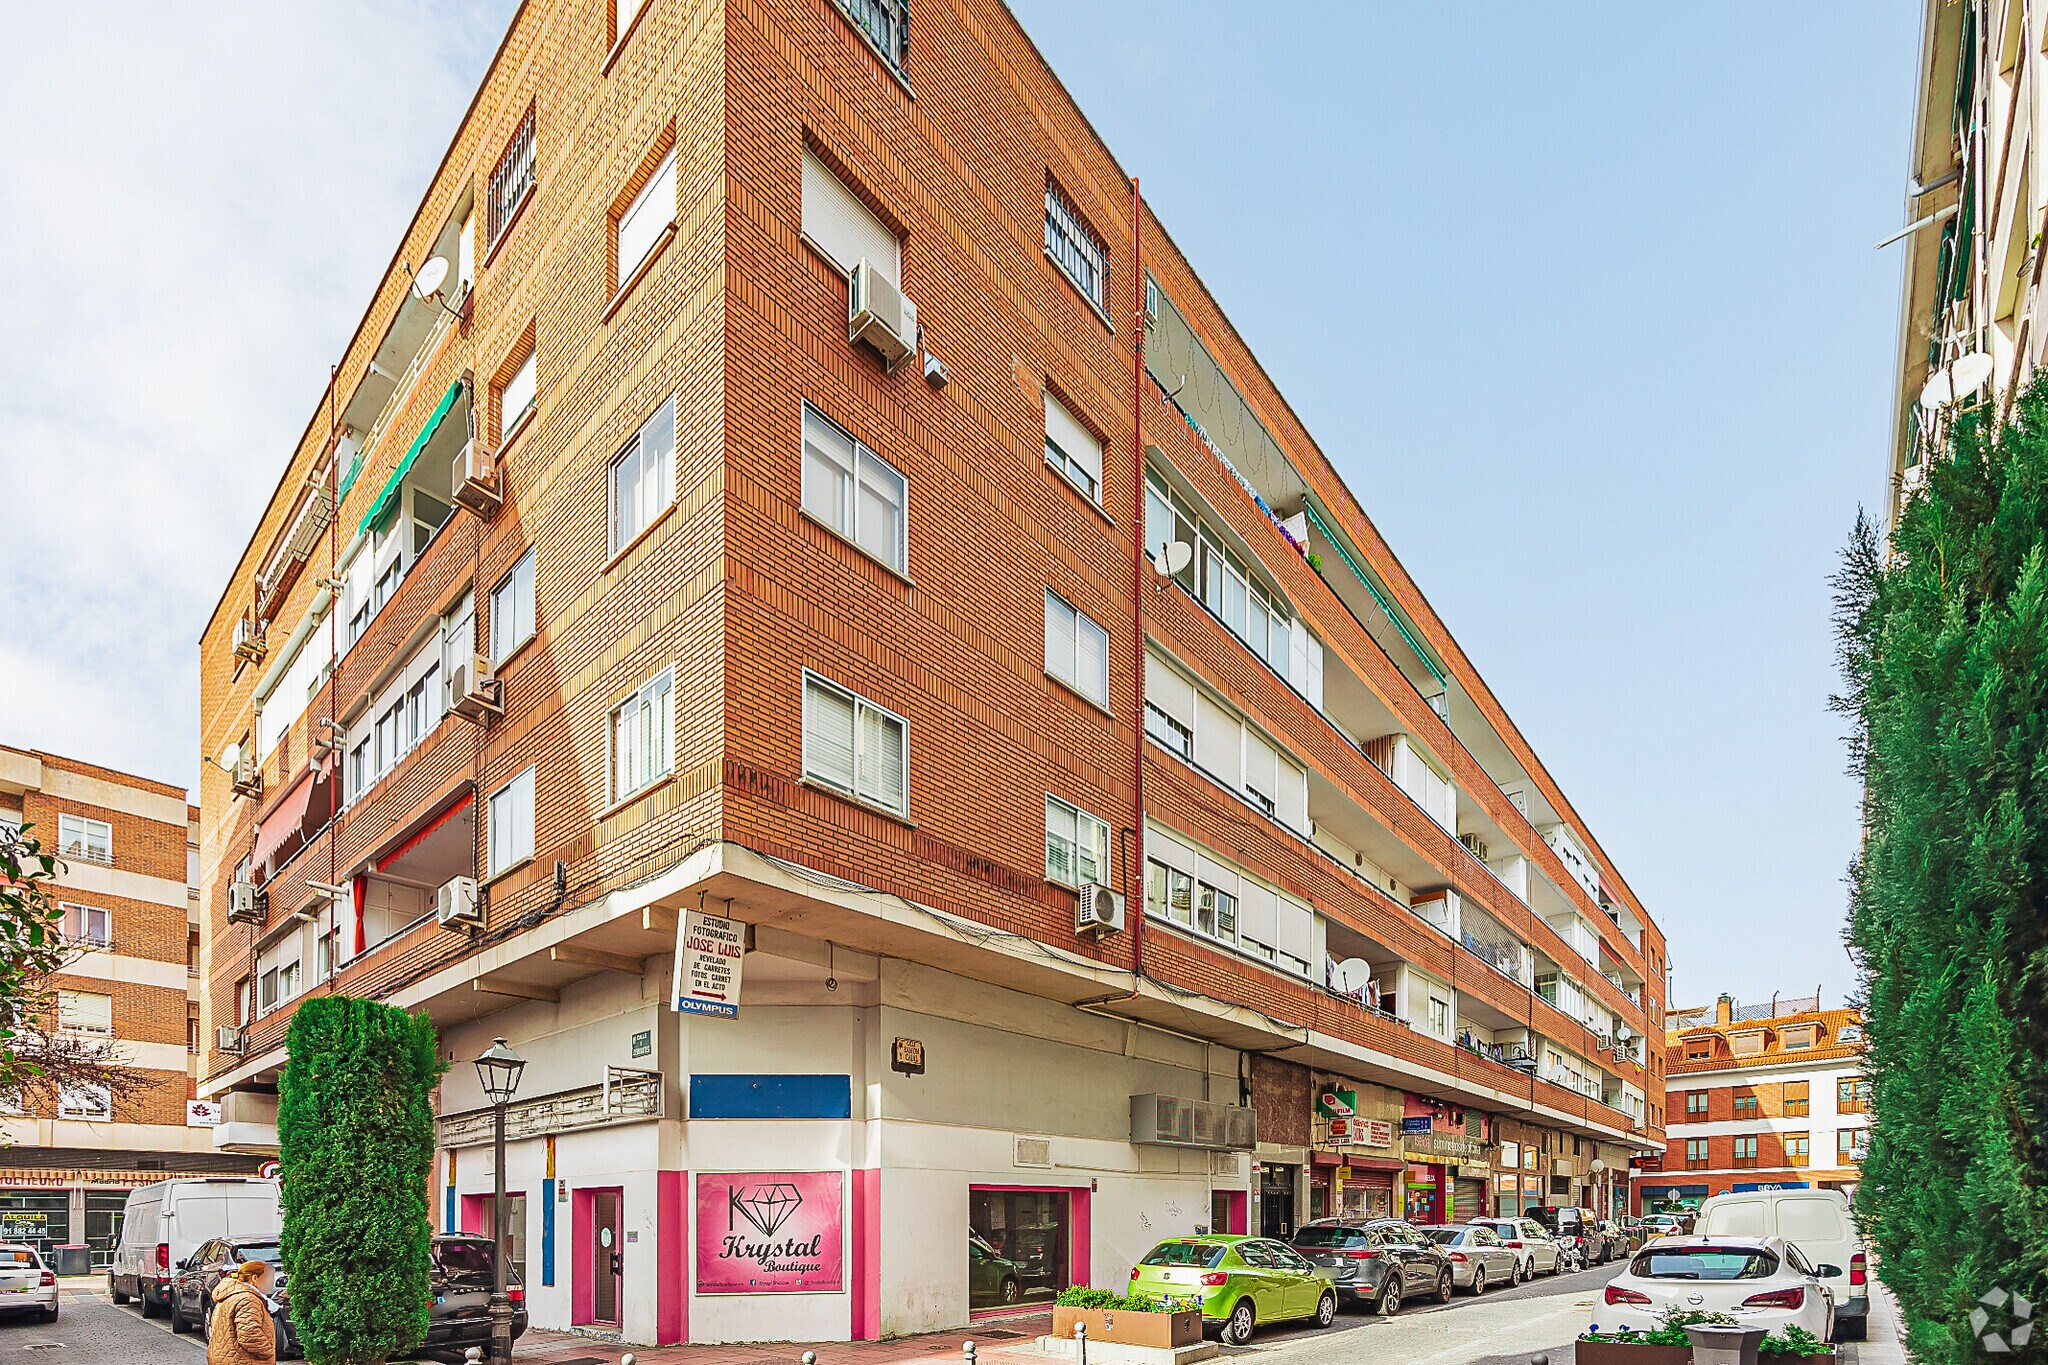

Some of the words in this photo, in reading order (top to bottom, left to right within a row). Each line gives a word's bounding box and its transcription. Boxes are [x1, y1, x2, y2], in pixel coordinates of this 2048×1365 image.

[703, 916, 730, 930] ESTUDIO
[693, 925, 738, 943] FOTOGRAFICO
[686, 936, 714, 953] JOSE
[718, 942, 741, 959] LUIS
[699, 954, 726, 966] REVELADO
[693, 962, 701, 970] DE
[704, 963, 731, 975] CARRETES
[691, 970, 708, 980] FOTOS
[711, 974, 731, 984] CARNET
[695, 979, 702, 987] EN
[704, 981, 710, 989] EL
[711, 982, 726, 991] ACTO
[681, 1000, 734, 1015] OLYMPUS
[3, 1227, 12, 1235] 91
[13, 1227, 27, 1235] 882
[28, 1227, 37, 1235] 44
[719, 1234, 822, 1266] Krystal
[763, 1260, 822, 1275] Boutique
